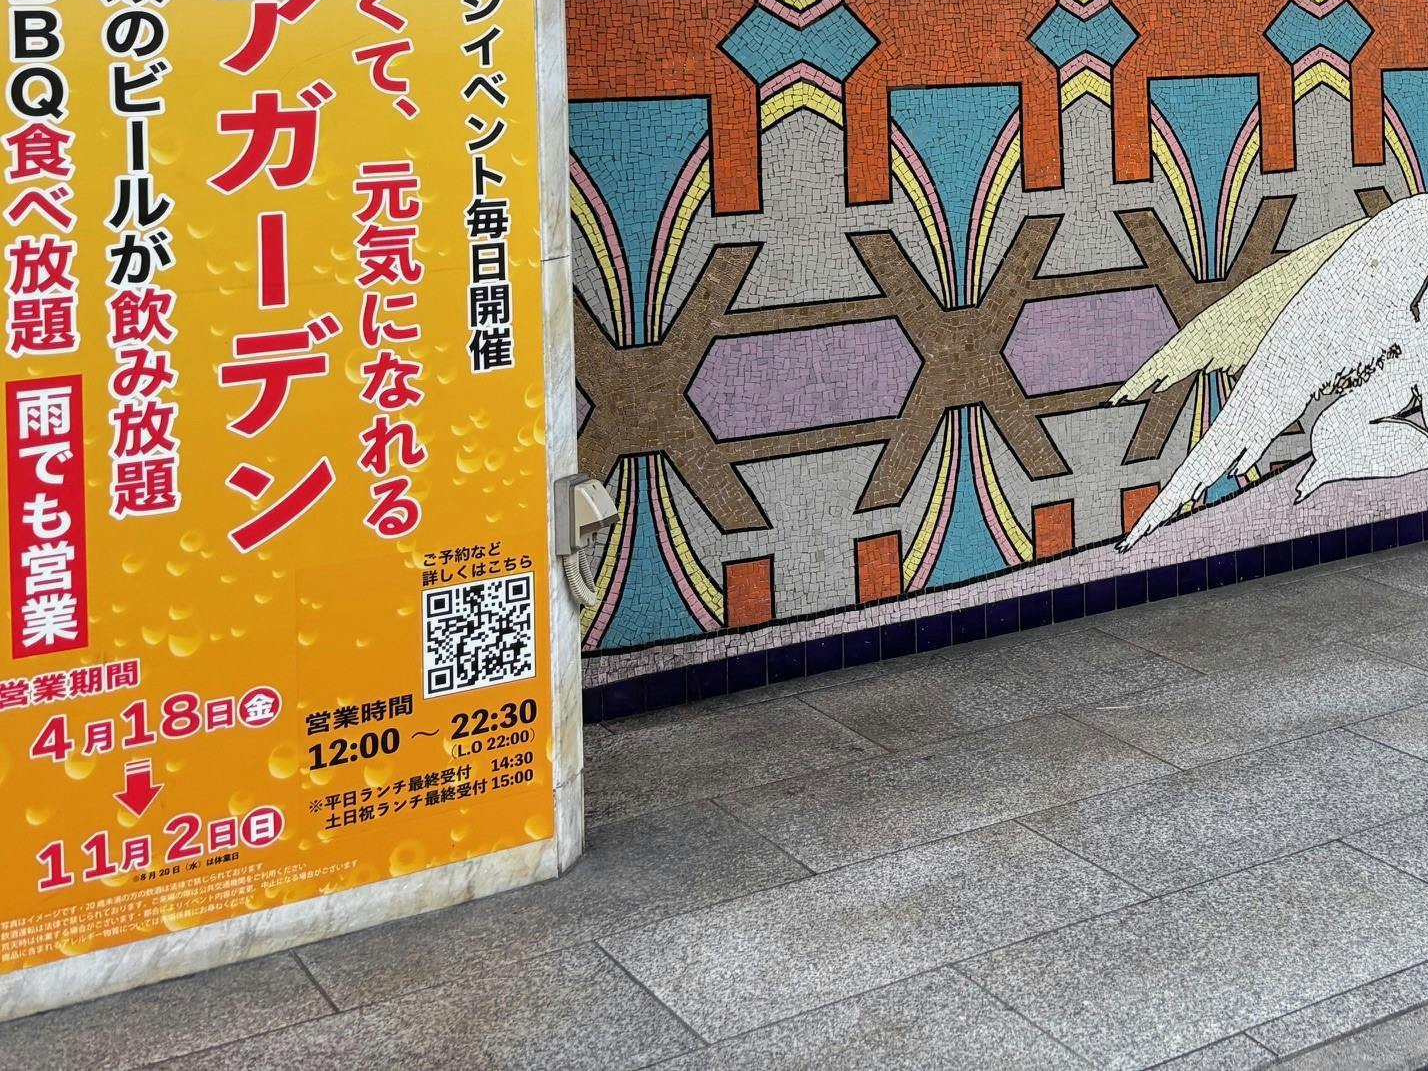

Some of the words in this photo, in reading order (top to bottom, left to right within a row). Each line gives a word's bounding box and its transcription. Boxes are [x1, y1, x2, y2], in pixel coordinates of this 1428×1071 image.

[17, 388, 78, 646] 雨でも営業
[422, 555, 532, 586] 詳しくはこちら
[423, 541, 501, 567] ご予約など
[0, 660, 138, 709] 営業期間
[306, 694, 413, 735] 営業時間
[309, 728, 400, 770] 12:00
[451, 699, 537, 740] 22:30
[491, 751, 533, 772] 14:30
[492, 769, 534, 790] 15:00
